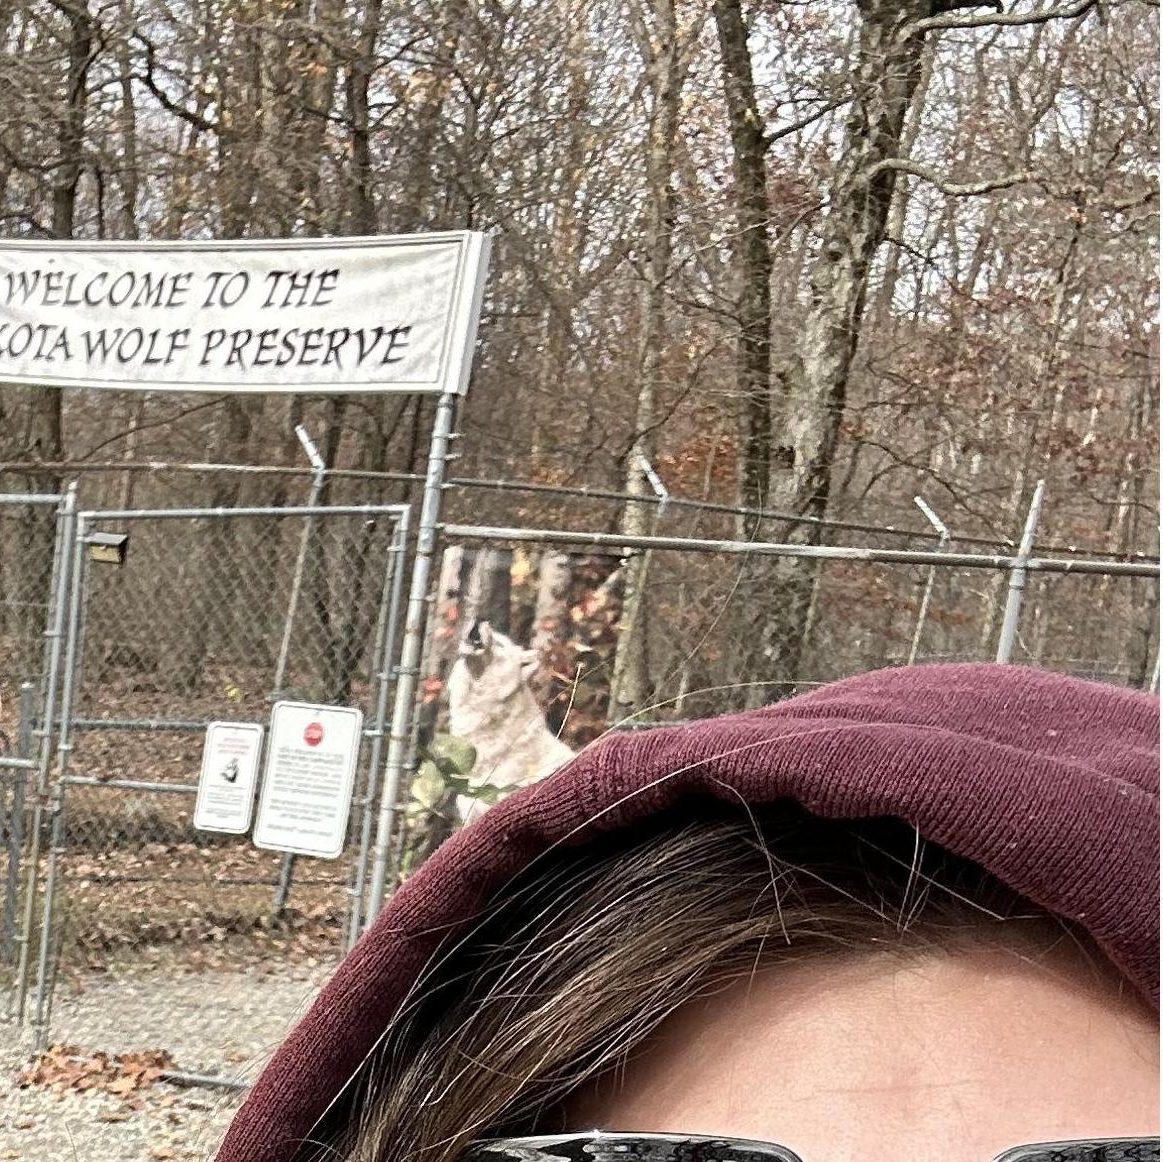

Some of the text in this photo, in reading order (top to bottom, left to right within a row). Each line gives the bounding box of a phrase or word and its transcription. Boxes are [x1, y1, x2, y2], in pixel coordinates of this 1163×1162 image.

[4, 268, 340, 308] WELCOME TO THE
[80, 326, 191, 366] WOLF
[198, 325, 412, 371] PRESERVE
